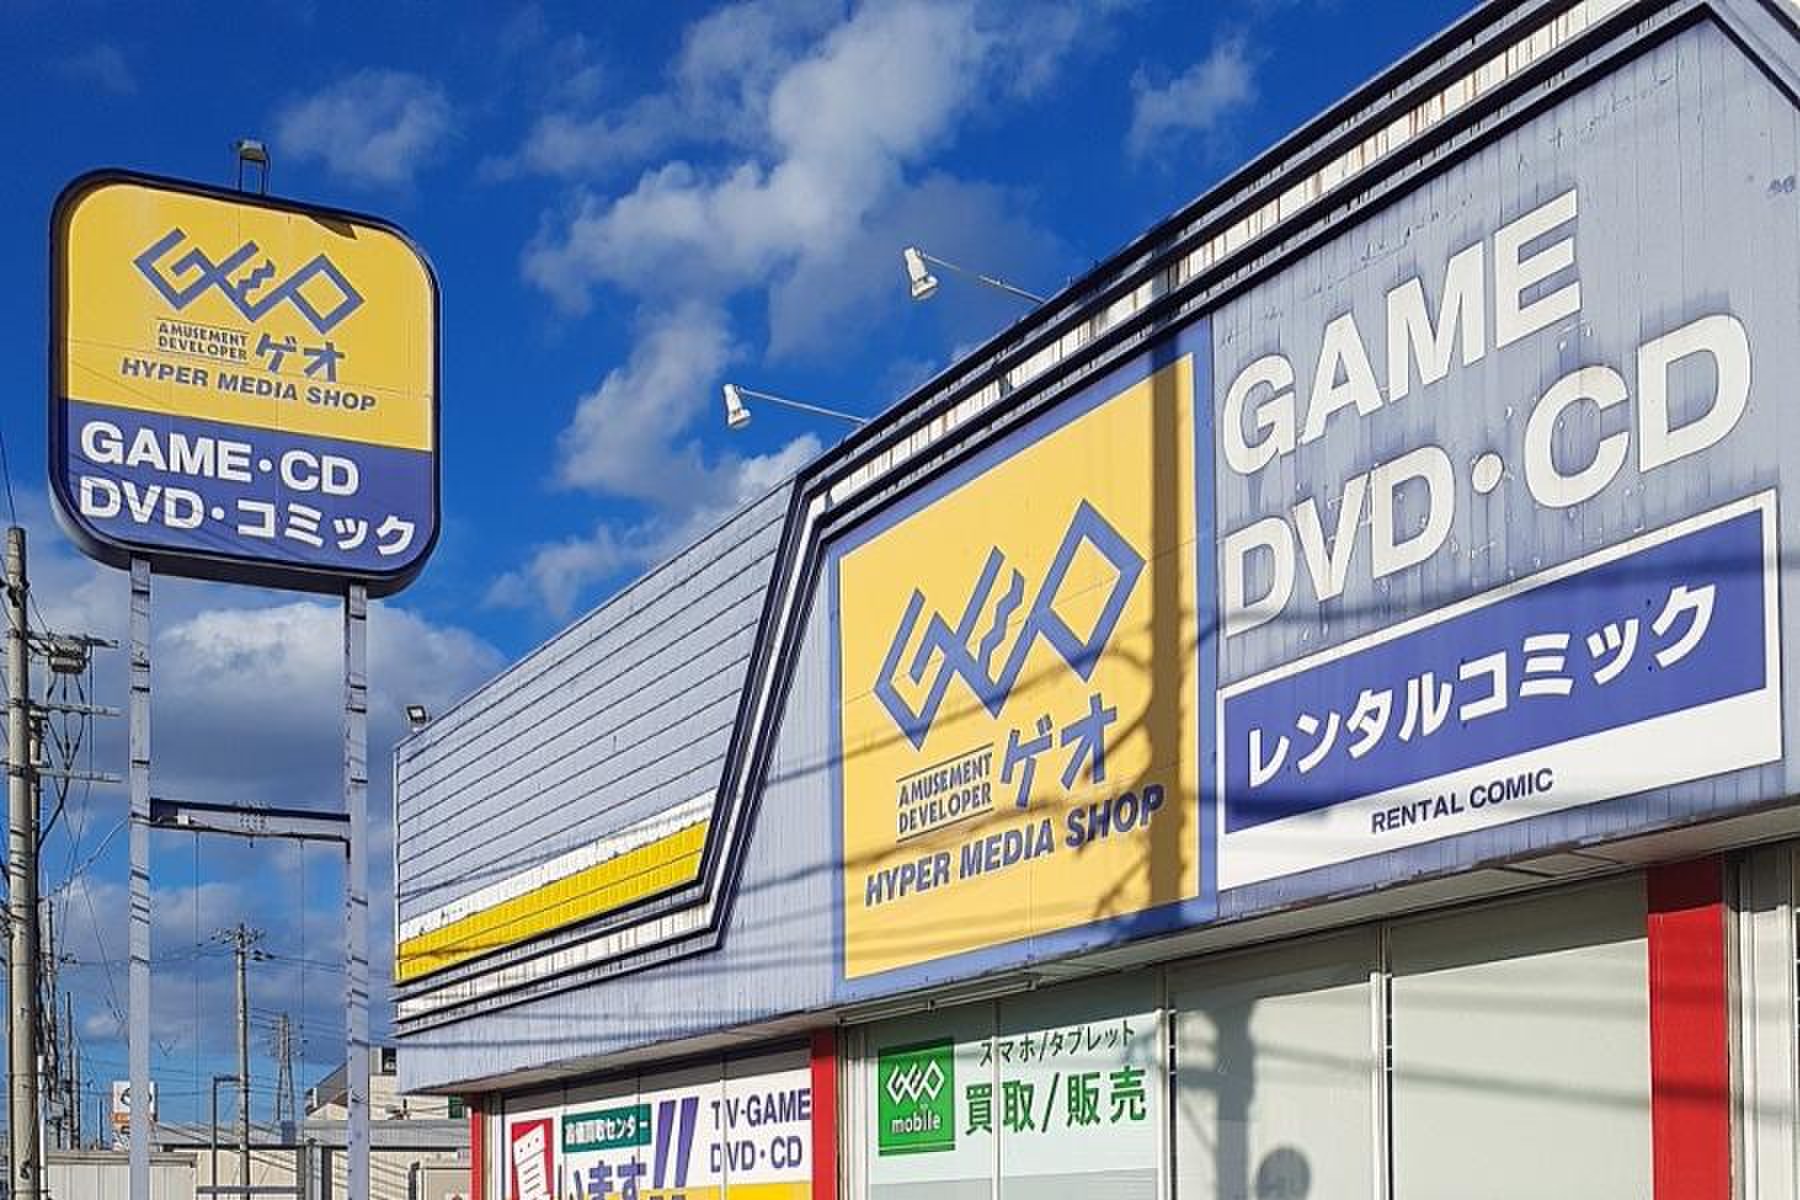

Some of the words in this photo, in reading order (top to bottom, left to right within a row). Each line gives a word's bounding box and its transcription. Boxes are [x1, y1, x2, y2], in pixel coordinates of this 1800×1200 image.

[157, 322, 248, 347] AMUSEMENT
[157, 335, 248, 361] DEVELOPER
[255, 332, 345, 383] ゲオ
[1221, 187, 1582, 476] GAME
[121, 357, 208, 387] HYPER
[217, 372, 298, 401] MEDIA
[306, 386, 377, 412] SHOP
[1247, 582, 1717, 790] レンタルコミック
[1000, 693, 1118, 808] ゲオ
[898, 751, 992, 808] AMUSEMENT
[1371, 795, 1464, 835] RENTAL
[1469, 767, 1554, 810] COMIC
[898, 782, 992, 835] DEVELOPER
[865, 852, 950, 907] HYPER
[959, 818, 1055, 881] MEDIA
[1065, 783, 1166, 848] SHOP
[891, 1109, 942, 1135] mobile
[965, 1064, 1147, 1136] 買取/販売
